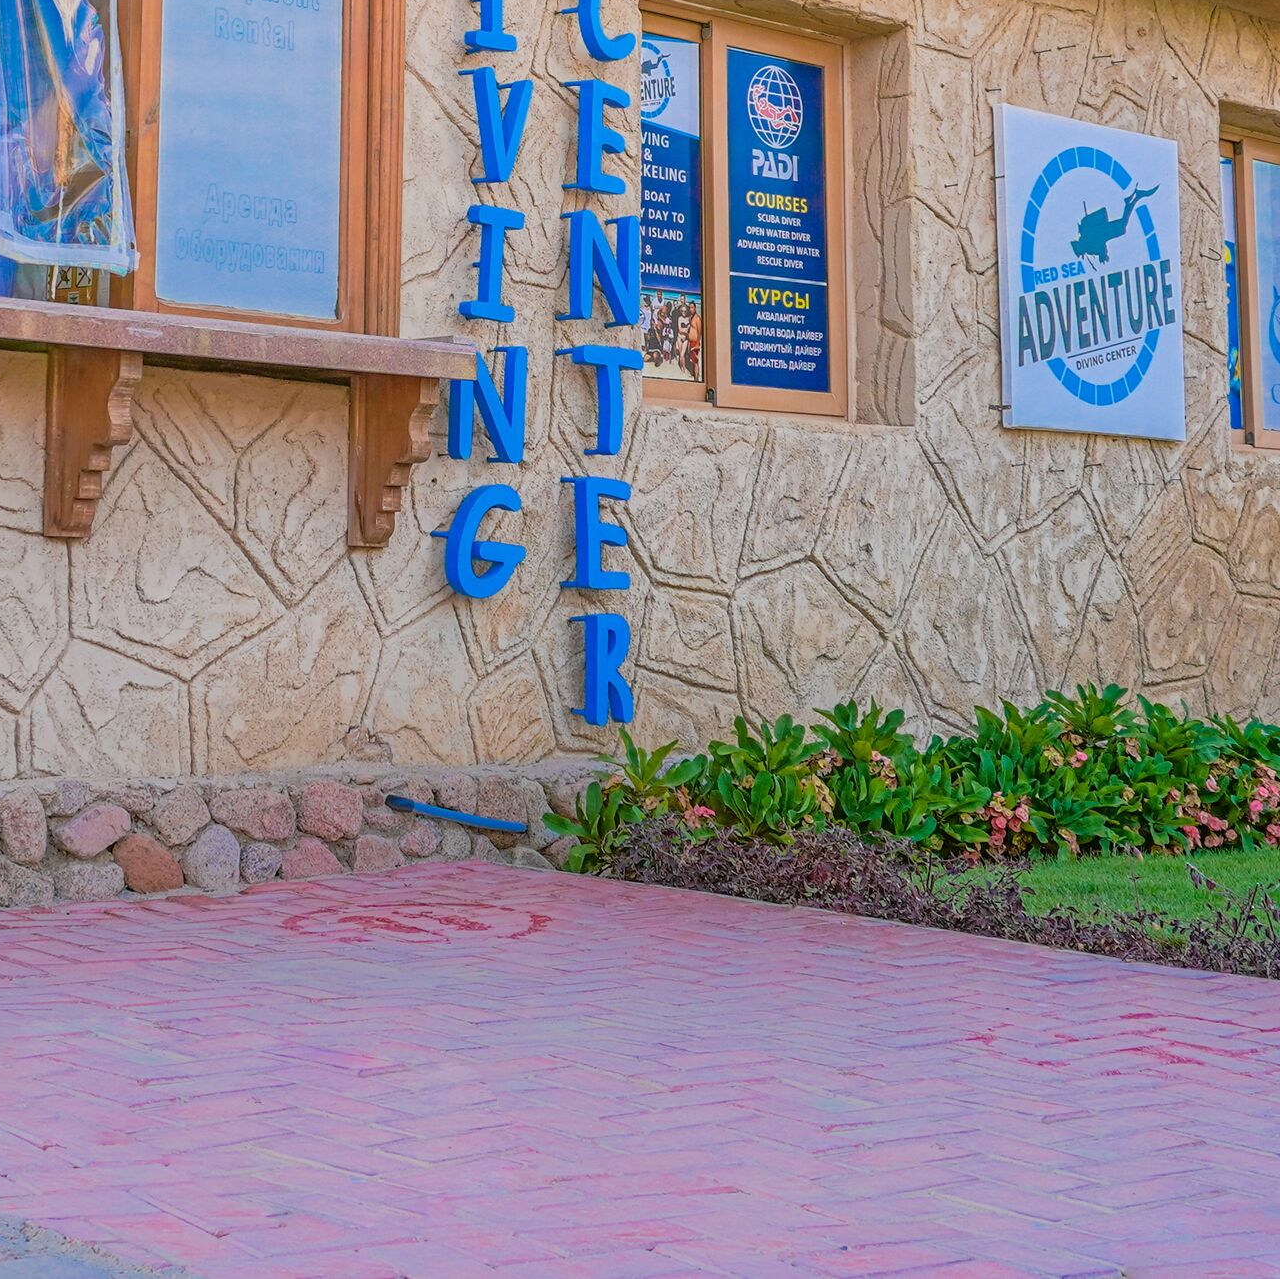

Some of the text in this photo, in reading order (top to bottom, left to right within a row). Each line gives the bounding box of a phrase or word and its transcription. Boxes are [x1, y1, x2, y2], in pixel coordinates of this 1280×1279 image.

[213, 7, 296, 50] Rental
[641, 76, 676, 100] ENTURE
[640, 131, 670, 149] VING
[643, 147, 652, 162] &
[640, 163, 687, 183] KELING
[752, 148, 799, 182] PADI
[203, 182, 298, 228] Аренда
[644, 190, 671, 204] BOAT
[746, 190, 808, 214] COURSES
[648, 208, 669, 222] DAY
[672, 211, 685, 224] TO
[757, 212, 801, 227] SCUBA DIVER
[648, 226, 684, 242] ISLAND
[746, 225, 811, 242] OPEN WATER DIVER
[174, 227, 325, 276] Оборудования
[645, 244, 653, 256] &
[737, 239, 820, 258] ADVANCED OPEN WATER
[640, 261, 691, 279] OHAMMED
[757, 255, 804, 270] RESCUE DIVER
[1034, 260, 1086, 285] RED SEA
[748, 287, 810, 310] КУРСЫ
[756, 311, 805, 324] АКВАЛАНГИСТ
[1018, 259, 1176, 367] ADVENTURE
[737, 324, 824, 342] ОТКРЫТАЯ ВОДА ДАЙВЕР
[740, 340, 822, 357] ПРОДВИНУТЫЙ ДАЙВЕР
[747, 357, 816, 371] СПАСАТЕЛЬ ДАЙВЕР
[1076, 345, 1137, 371] DIVING CENTER
